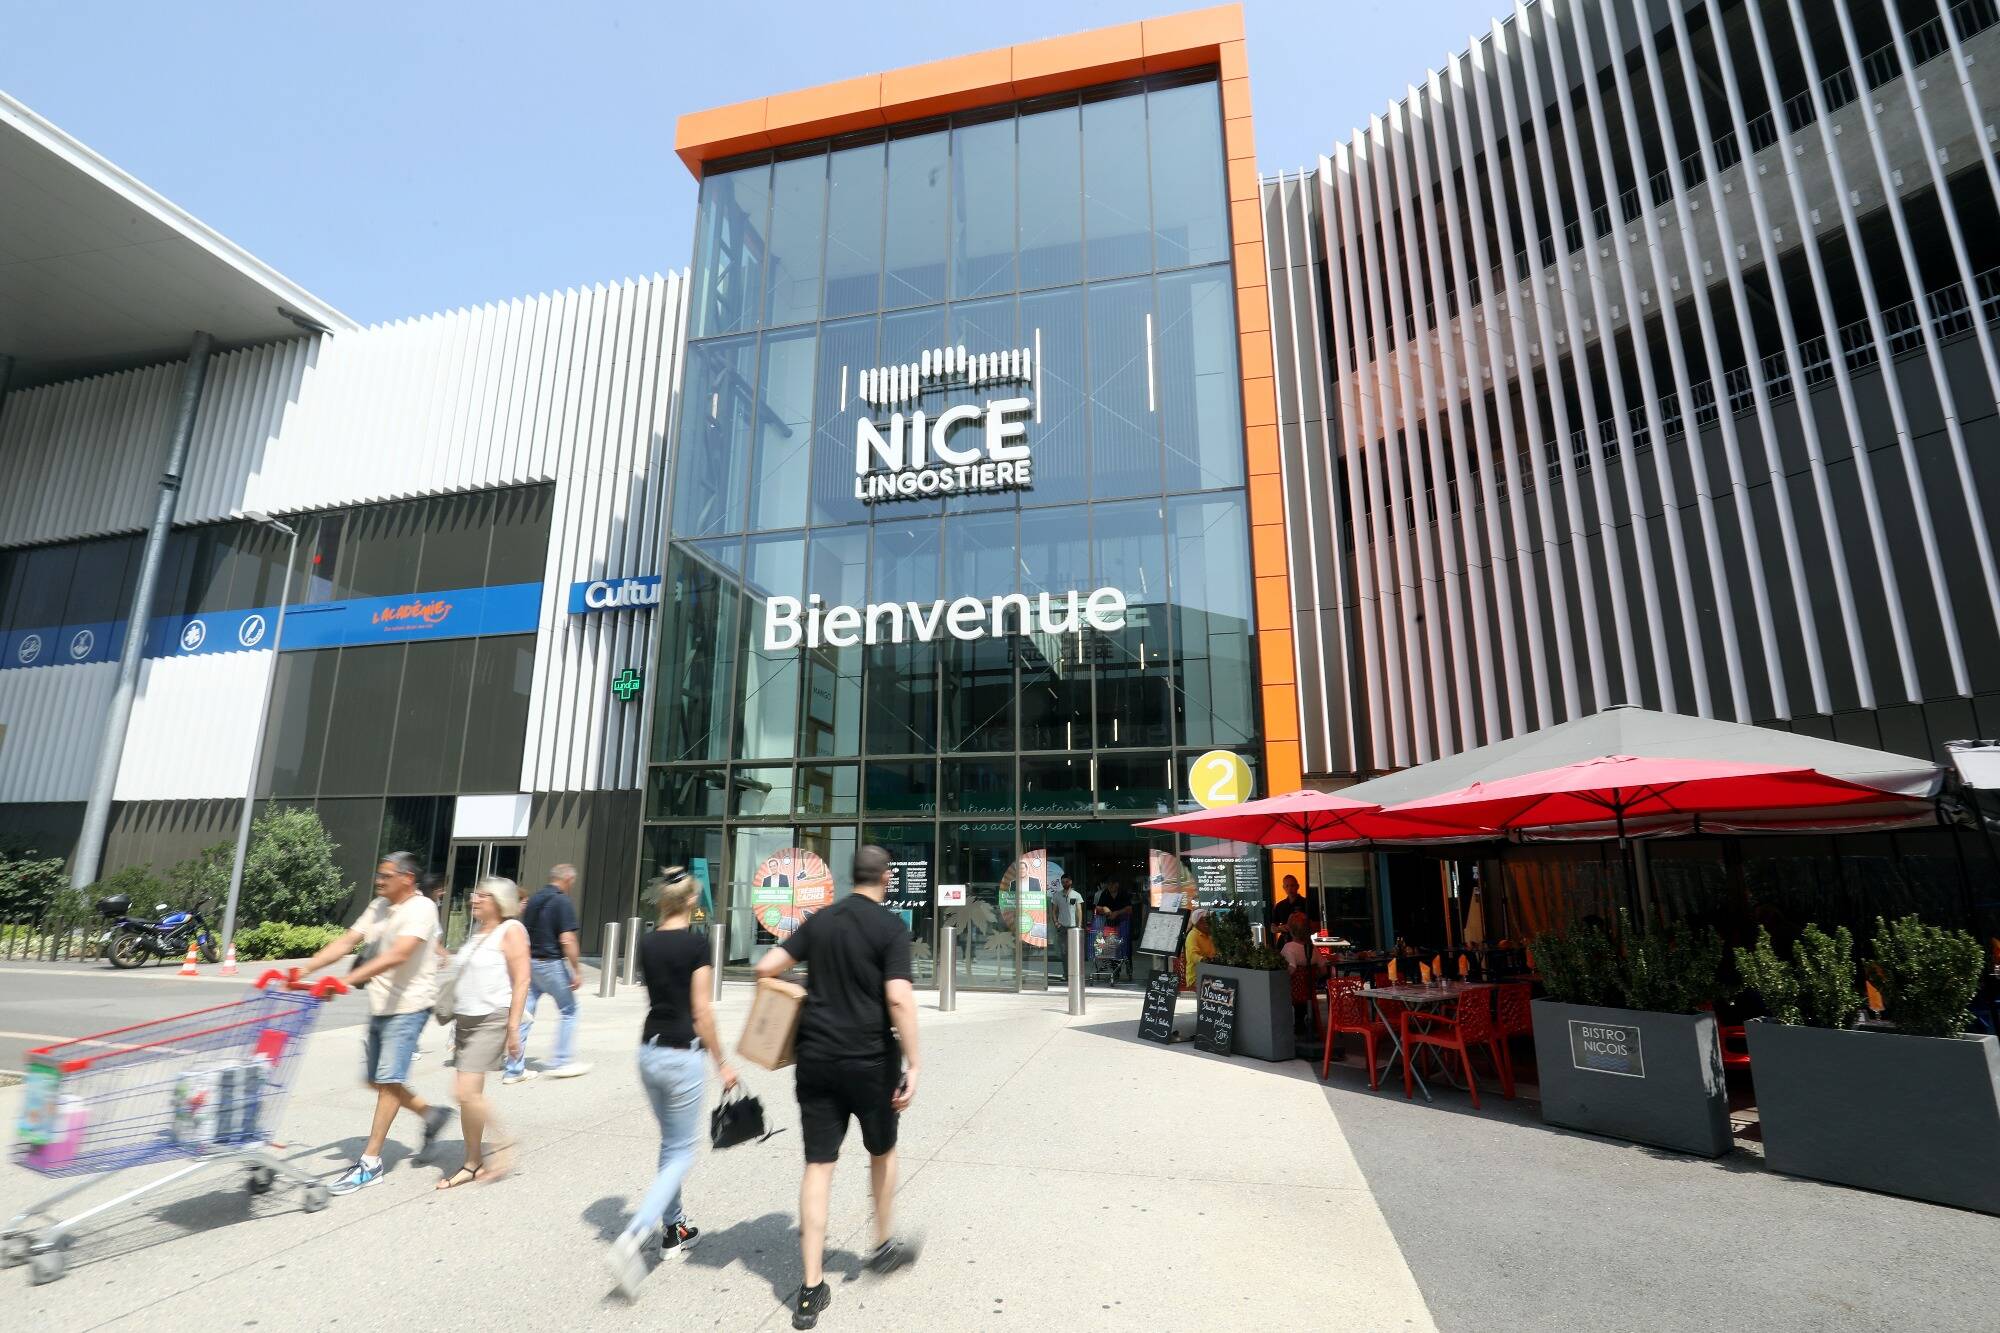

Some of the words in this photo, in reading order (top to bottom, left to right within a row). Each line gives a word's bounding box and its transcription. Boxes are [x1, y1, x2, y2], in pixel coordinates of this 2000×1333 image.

[856, 398, 1031, 476] NICE
[855, 459, 1031, 499] LINGOSTIERE
[764, 587, 1127, 651] Bienvenue
[1207, 758, 1237, 801] 2
[1582, 1026, 1626, 1042] BISTRO
[1584, 1040, 1628, 1056] NIÇOIS
